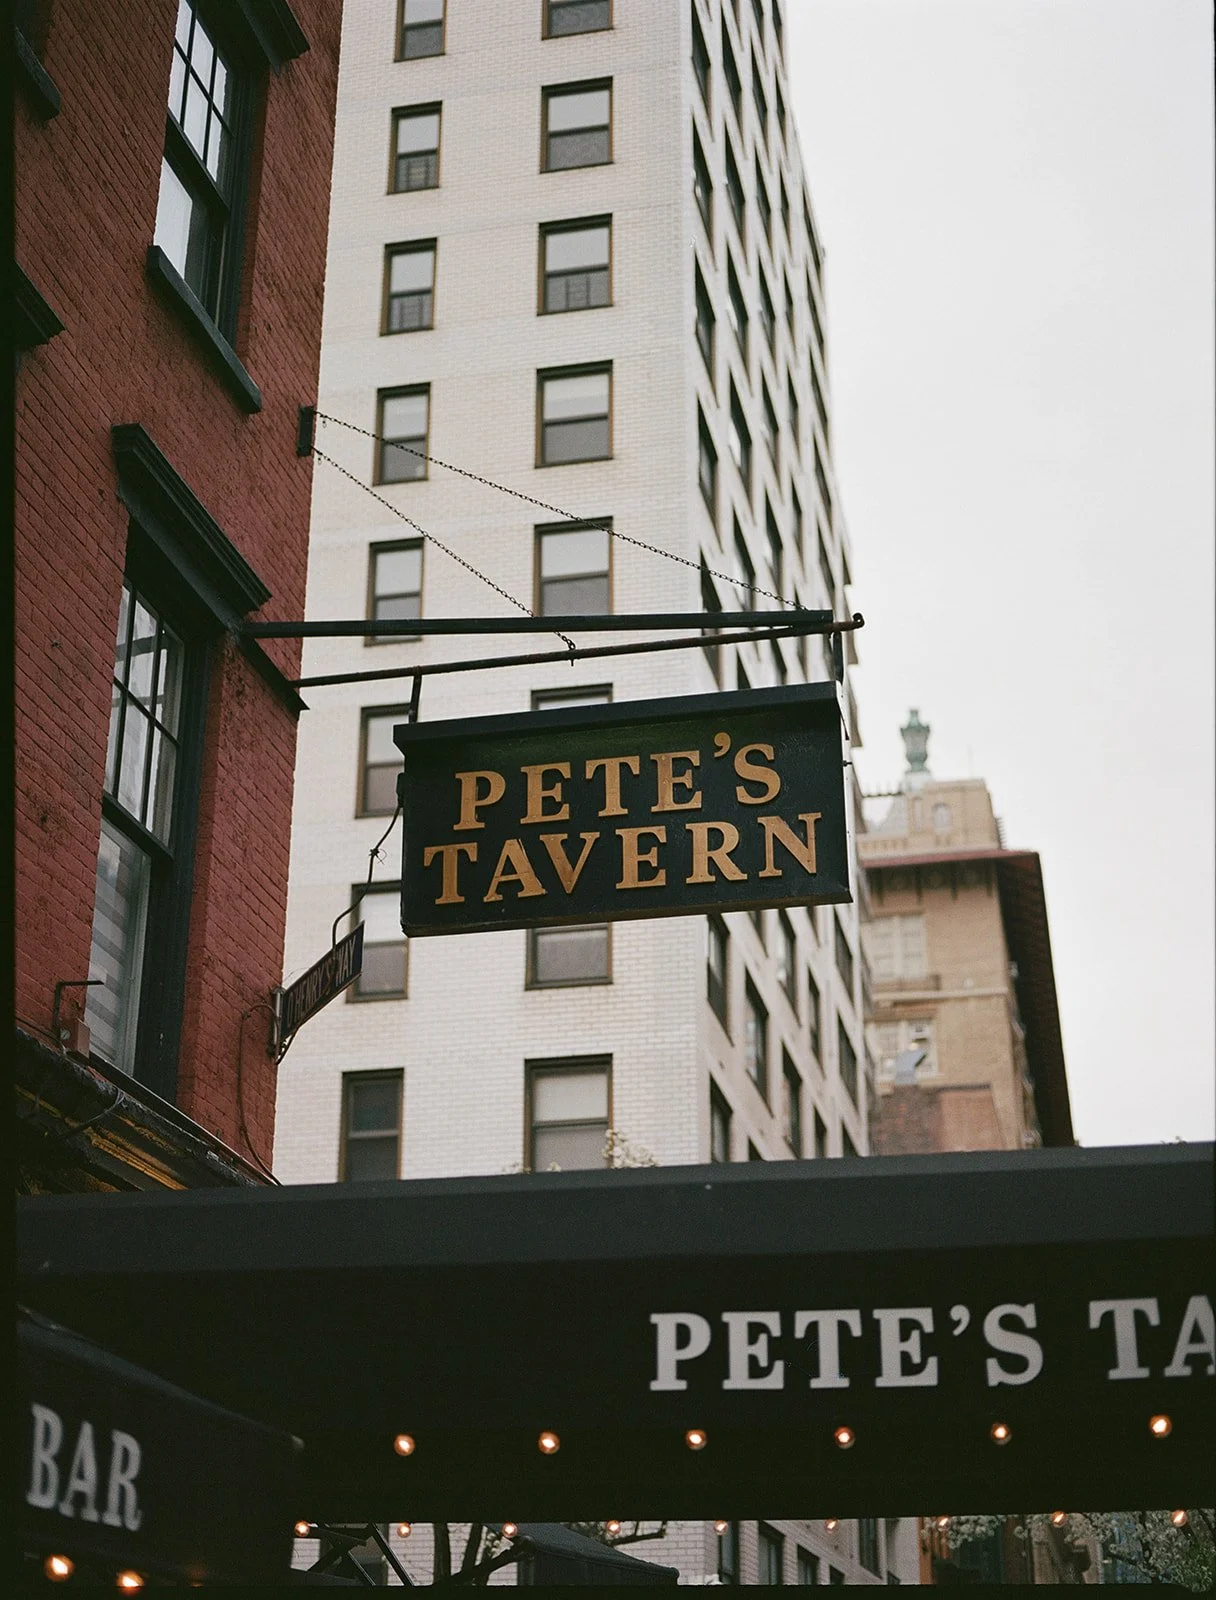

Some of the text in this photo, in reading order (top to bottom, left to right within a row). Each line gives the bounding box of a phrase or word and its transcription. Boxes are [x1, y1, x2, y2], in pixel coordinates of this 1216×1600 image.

[453, 732, 782, 831] PETE'S
[423, 812, 822, 905] TAVERN
[335, 935, 357, 988] WAY
[649, 1303, 1044, 1392] PETE'S
[25, 1401, 142, 1532] BAR
